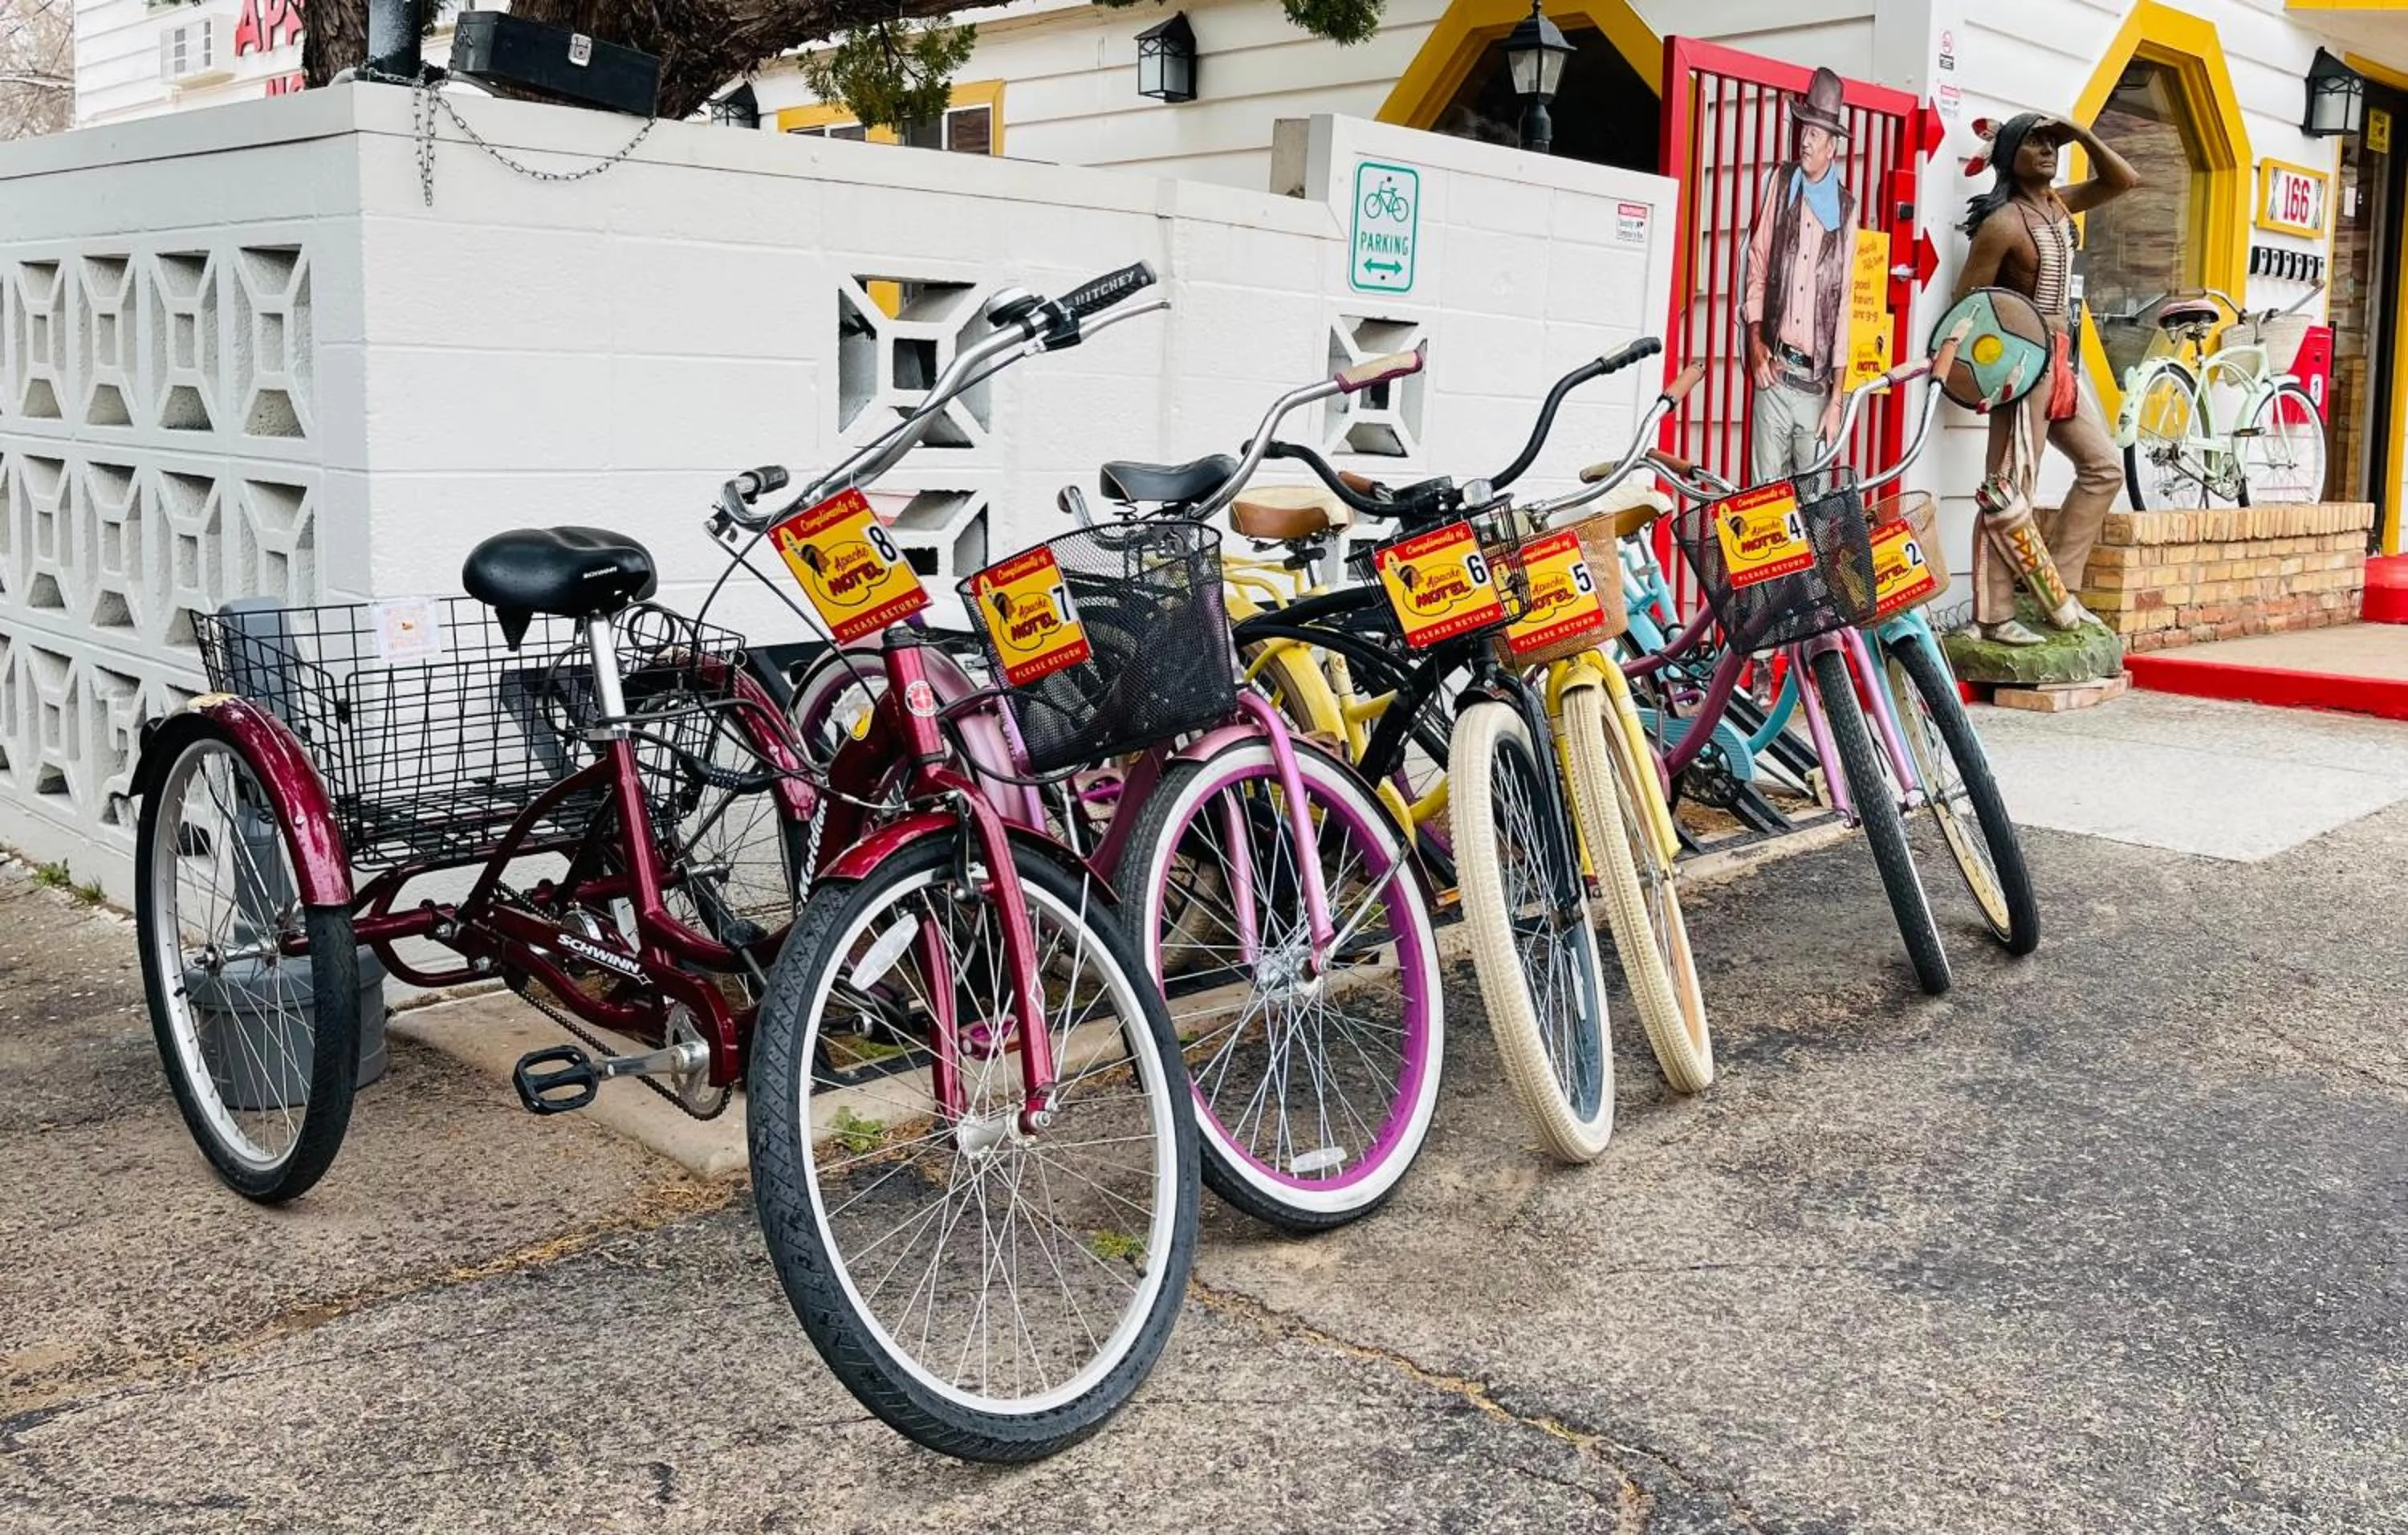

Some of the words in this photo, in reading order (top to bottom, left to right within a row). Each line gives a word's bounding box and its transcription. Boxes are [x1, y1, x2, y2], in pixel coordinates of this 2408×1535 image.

[2284, 174, 2310, 223] 166
[1361, 231, 1409, 256] PARKING
[800, 499, 848, 531] Compliments
[848, 496, 860, 511] of
[1789, 513, 1802, 539] 4
[868, 526, 897, 562] 8
[1406, 531, 1455, 556] Compliments
[1455, 527, 1466, 541] of
[1740, 531, 1789, 554] MOTEL
[1905, 542, 1923, 566] 2
[833, 544, 868, 571] Apache
[998, 555, 1038, 580] Compliments
[1466, 555, 1487, 584] 6
[1737, 567, 1770, 582] PLEASE
[1771, 557, 1806, 572] RETURN
[827, 560, 886, 597] MOTEL
[1426, 566, 1462, 588] Apache
[1531, 575, 1566, 596] Apache
[1572, 563, 1592, 592] 5
[1018, 596, 1046, 618] Apache
[1052, 585, 1071, 621] 7
[1415, 580, 1472, 609] MOTEL
[843, 615, 881, 637] PLEASE
[881, 597, 920, 621] RETURN
[1011, 611, 1059, 641] MOTEL
[1415, 625, 1453, 642] PLEASE
[1454, 609, 1495, 629] RETURN
[1519, 630, 1556, 648] PLEASE
[1557, 615, 1597, 634] RETURN
[1015, 660, 1045, 679] PLEASE
[1047, 646, 1081, 665] RETURN
[556, 934, 641, 975] SCHWINN
